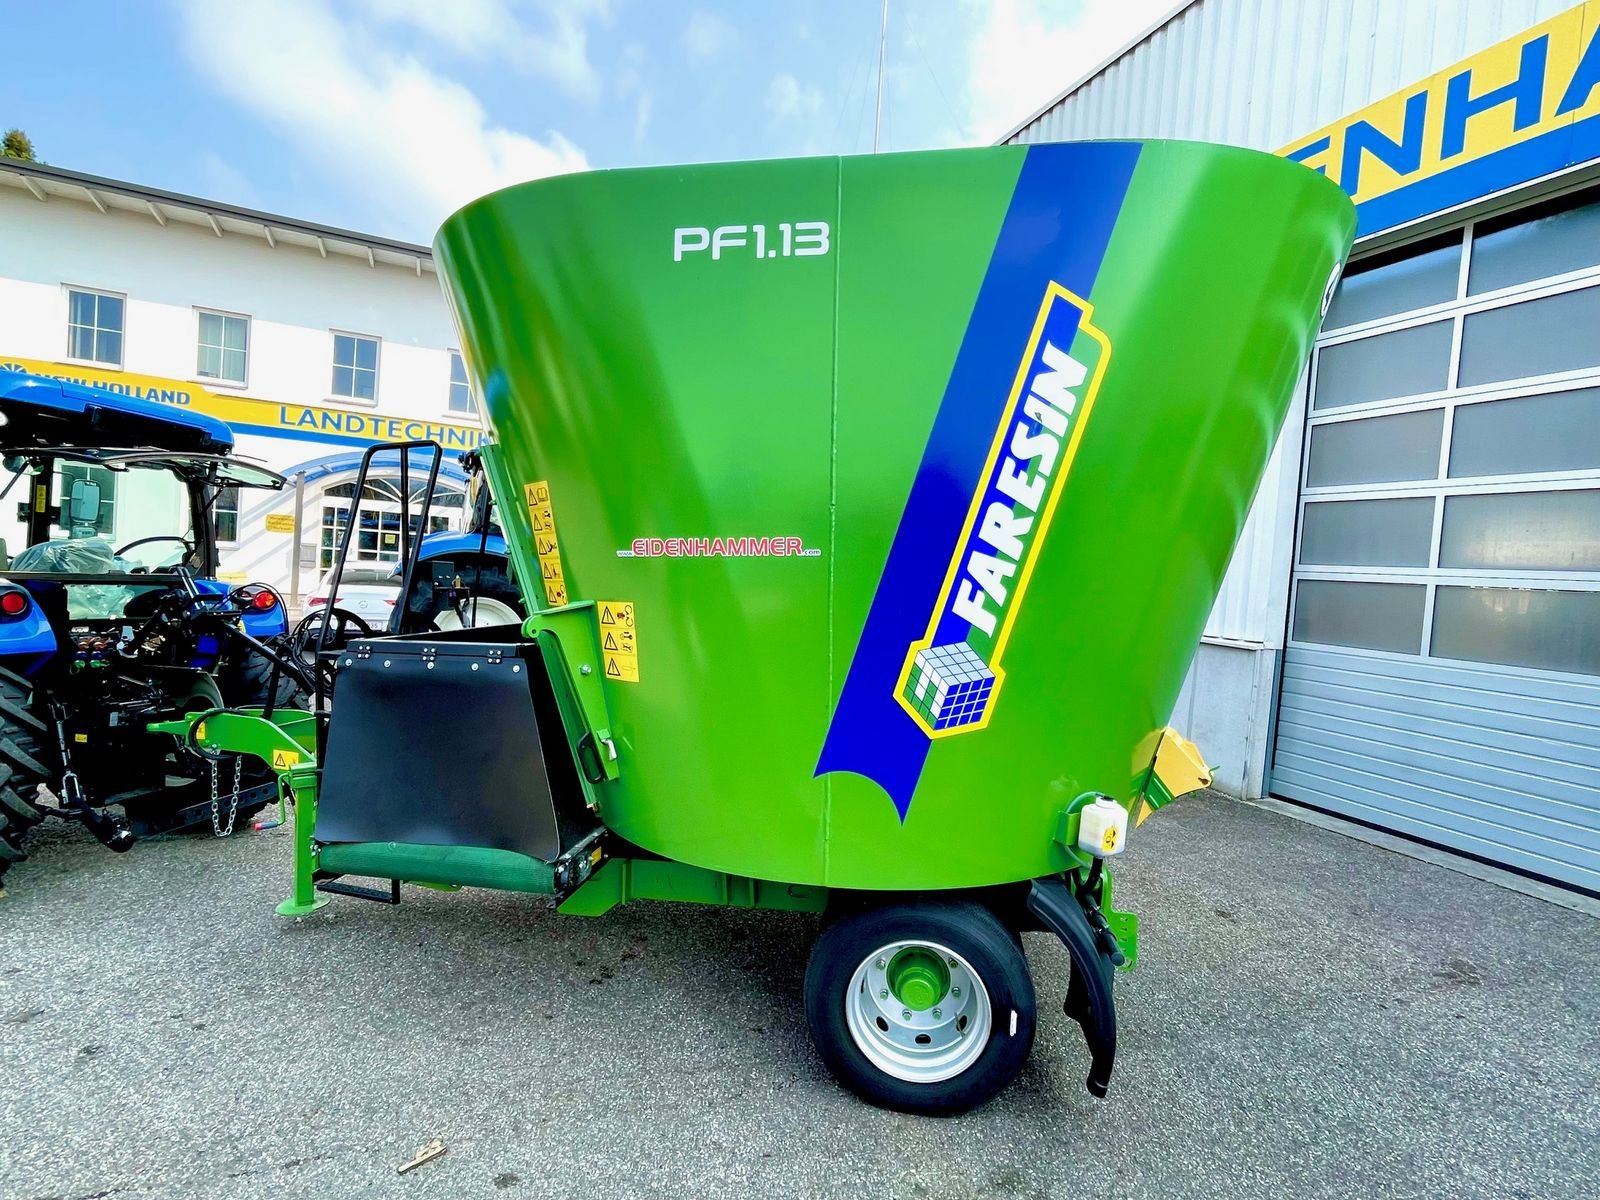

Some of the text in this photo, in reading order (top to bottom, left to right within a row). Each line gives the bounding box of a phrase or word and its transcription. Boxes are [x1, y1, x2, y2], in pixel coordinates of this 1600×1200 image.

[673, 221, 830, 262] PF1.13
[279, 405, 490, 448] LANDTECHNIK
[952, 339, 1088, 638] FARESIN
